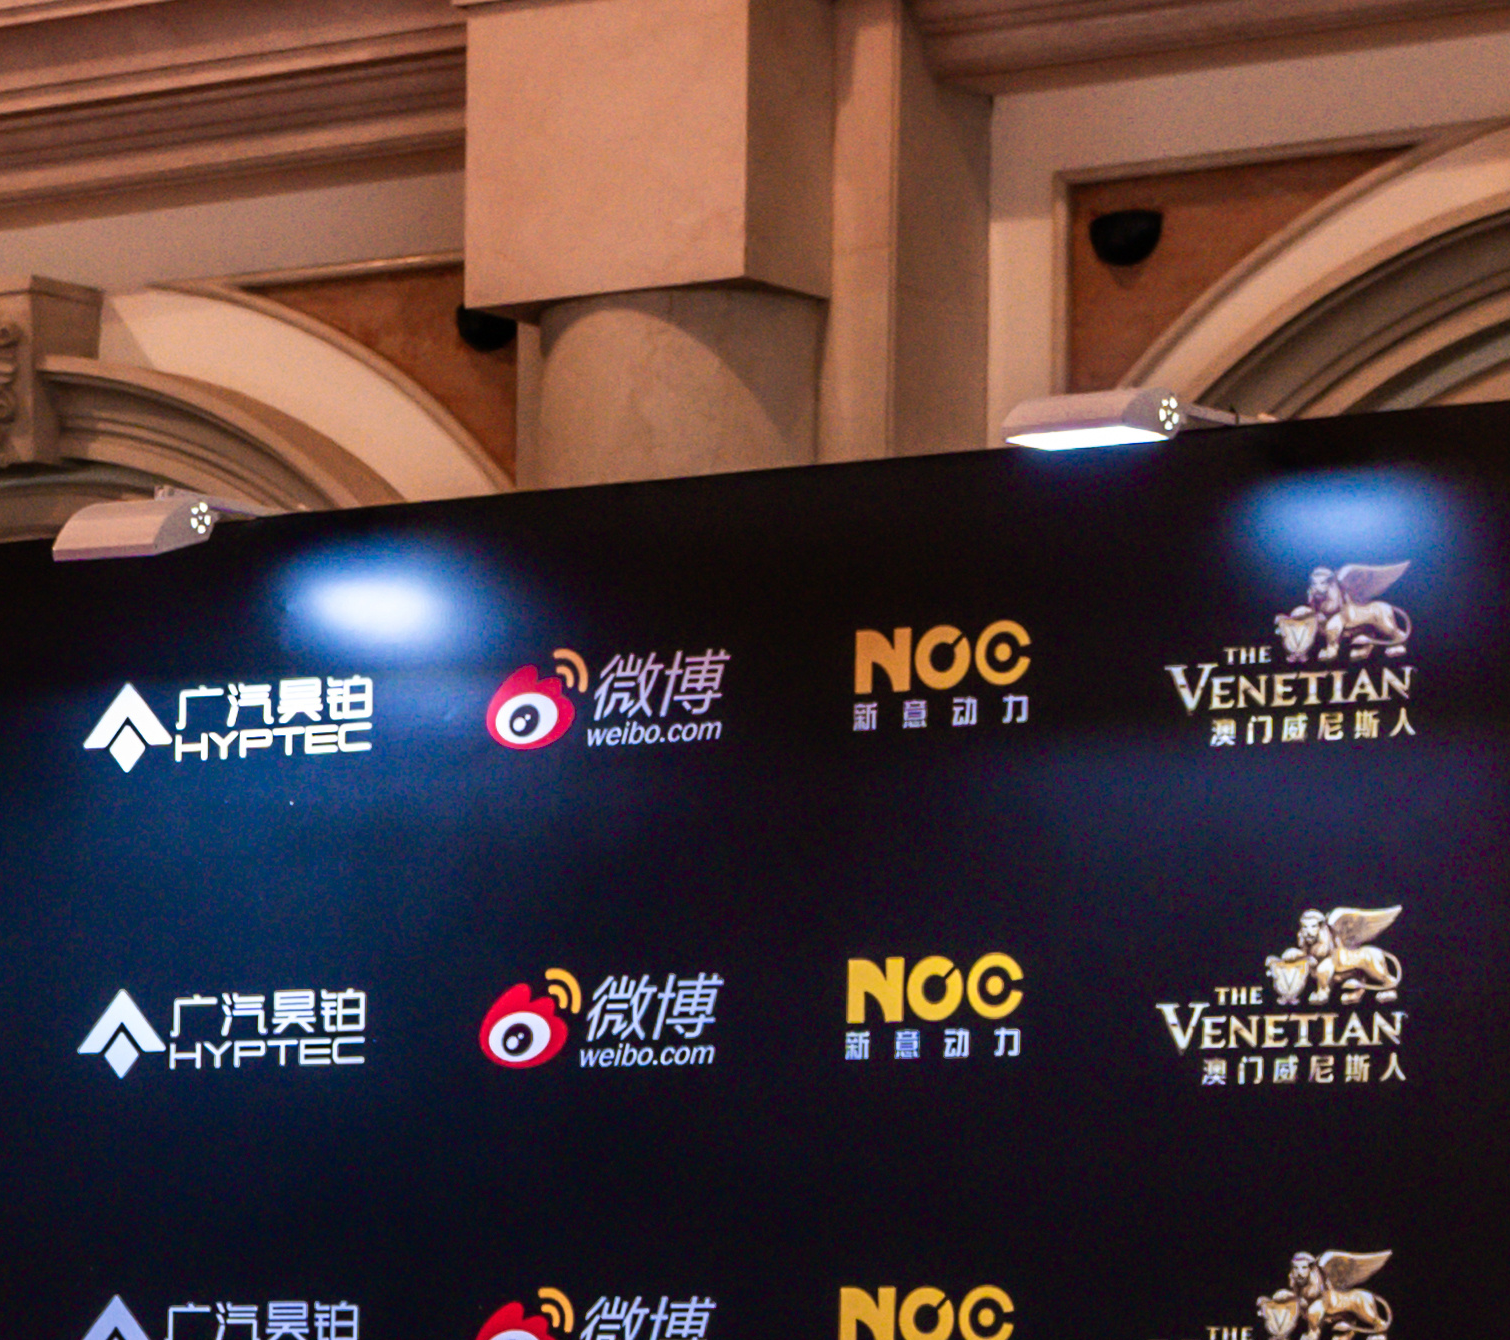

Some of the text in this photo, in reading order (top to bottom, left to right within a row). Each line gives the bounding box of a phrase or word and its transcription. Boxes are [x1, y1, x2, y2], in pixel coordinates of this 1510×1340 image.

[854, 619, 1032, 695] NOC
[1224, 645, 1272, 665] THE
[175, 673, 375, 731] 广汽昊铂
[593, 648, 731, 722] 微博
[1164, 662, 1414, 712] VENETIAN
[174, 720, 373, 763] HYPTEC
[586, 720, 723, 747] weibo.com
[1209, 707, 1416, 748] 澳门威尼斯人
[586, 971, 725, 1042] 微博
[846, 951, 1024, 1024] NOC
[1214, 986, 1263, 1006] THE
[169, 987, 367, 1038] 广汽昊铂
[1155, 1001, 1408, 1051] VENETIAN
[169, 1035, 366, 1070] HYPTEC
[579, 1042, 716, 1068] weibo.com
[844, 1026, 1022, 1060] 新意动力
[1201, 1051, 1407, 1087] 澳门威尼斯人
